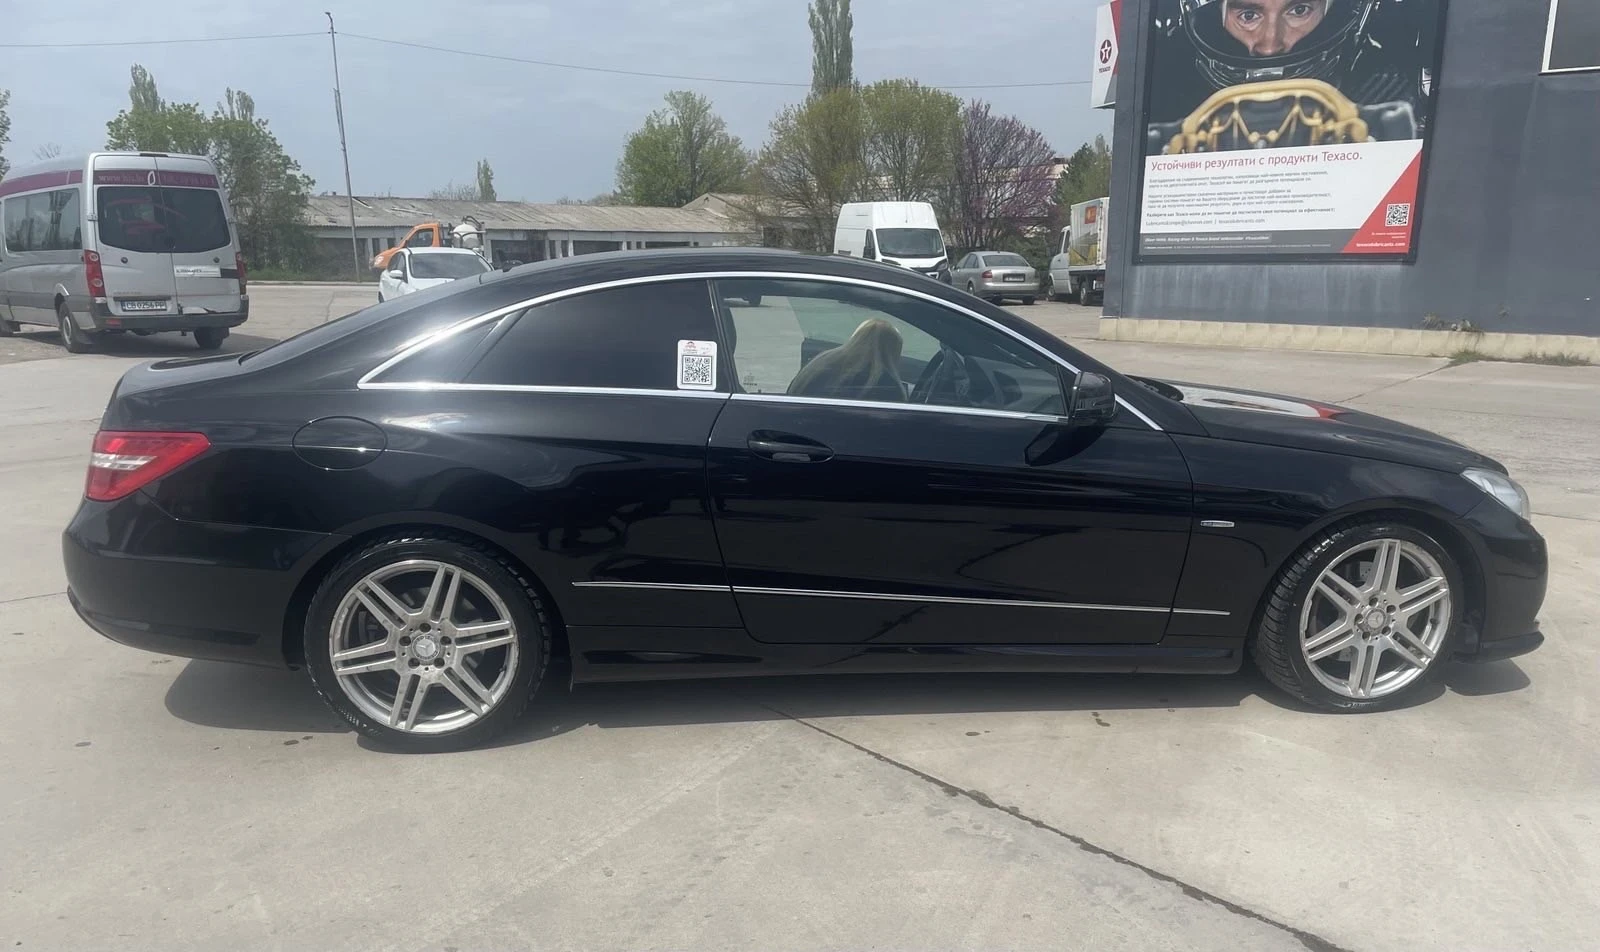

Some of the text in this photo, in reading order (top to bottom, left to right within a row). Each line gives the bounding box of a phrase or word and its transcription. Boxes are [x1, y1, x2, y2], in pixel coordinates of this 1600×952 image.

[1151, 151, 1363, 171] Устойчиви резултати с продукти Texaco.
